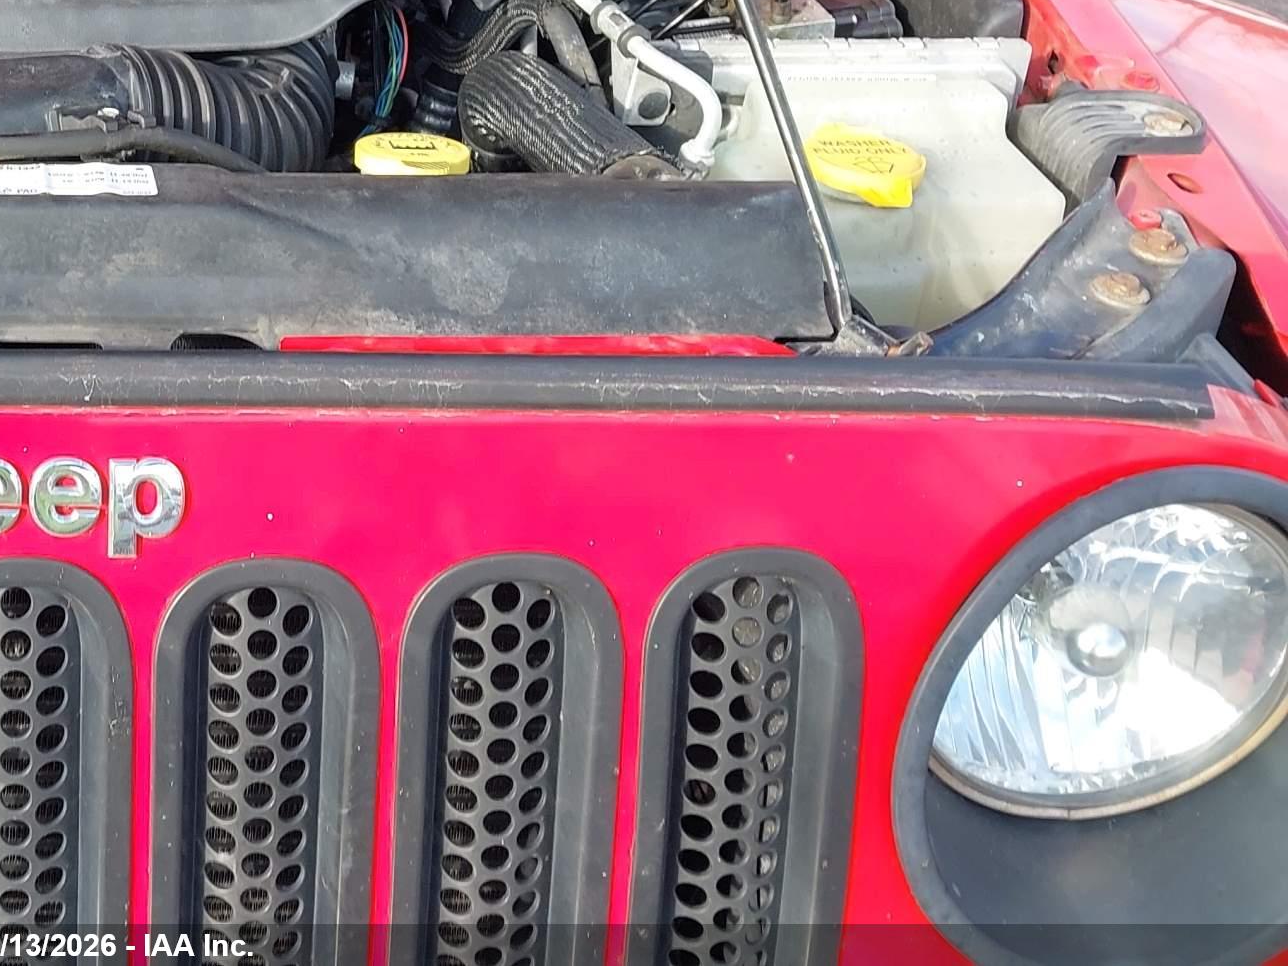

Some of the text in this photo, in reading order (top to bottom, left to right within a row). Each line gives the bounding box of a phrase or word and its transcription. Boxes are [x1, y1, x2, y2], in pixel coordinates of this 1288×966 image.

[818, 138, 891, 147] WASHER
[812, 146, 908, 155] FLUID ONLY
